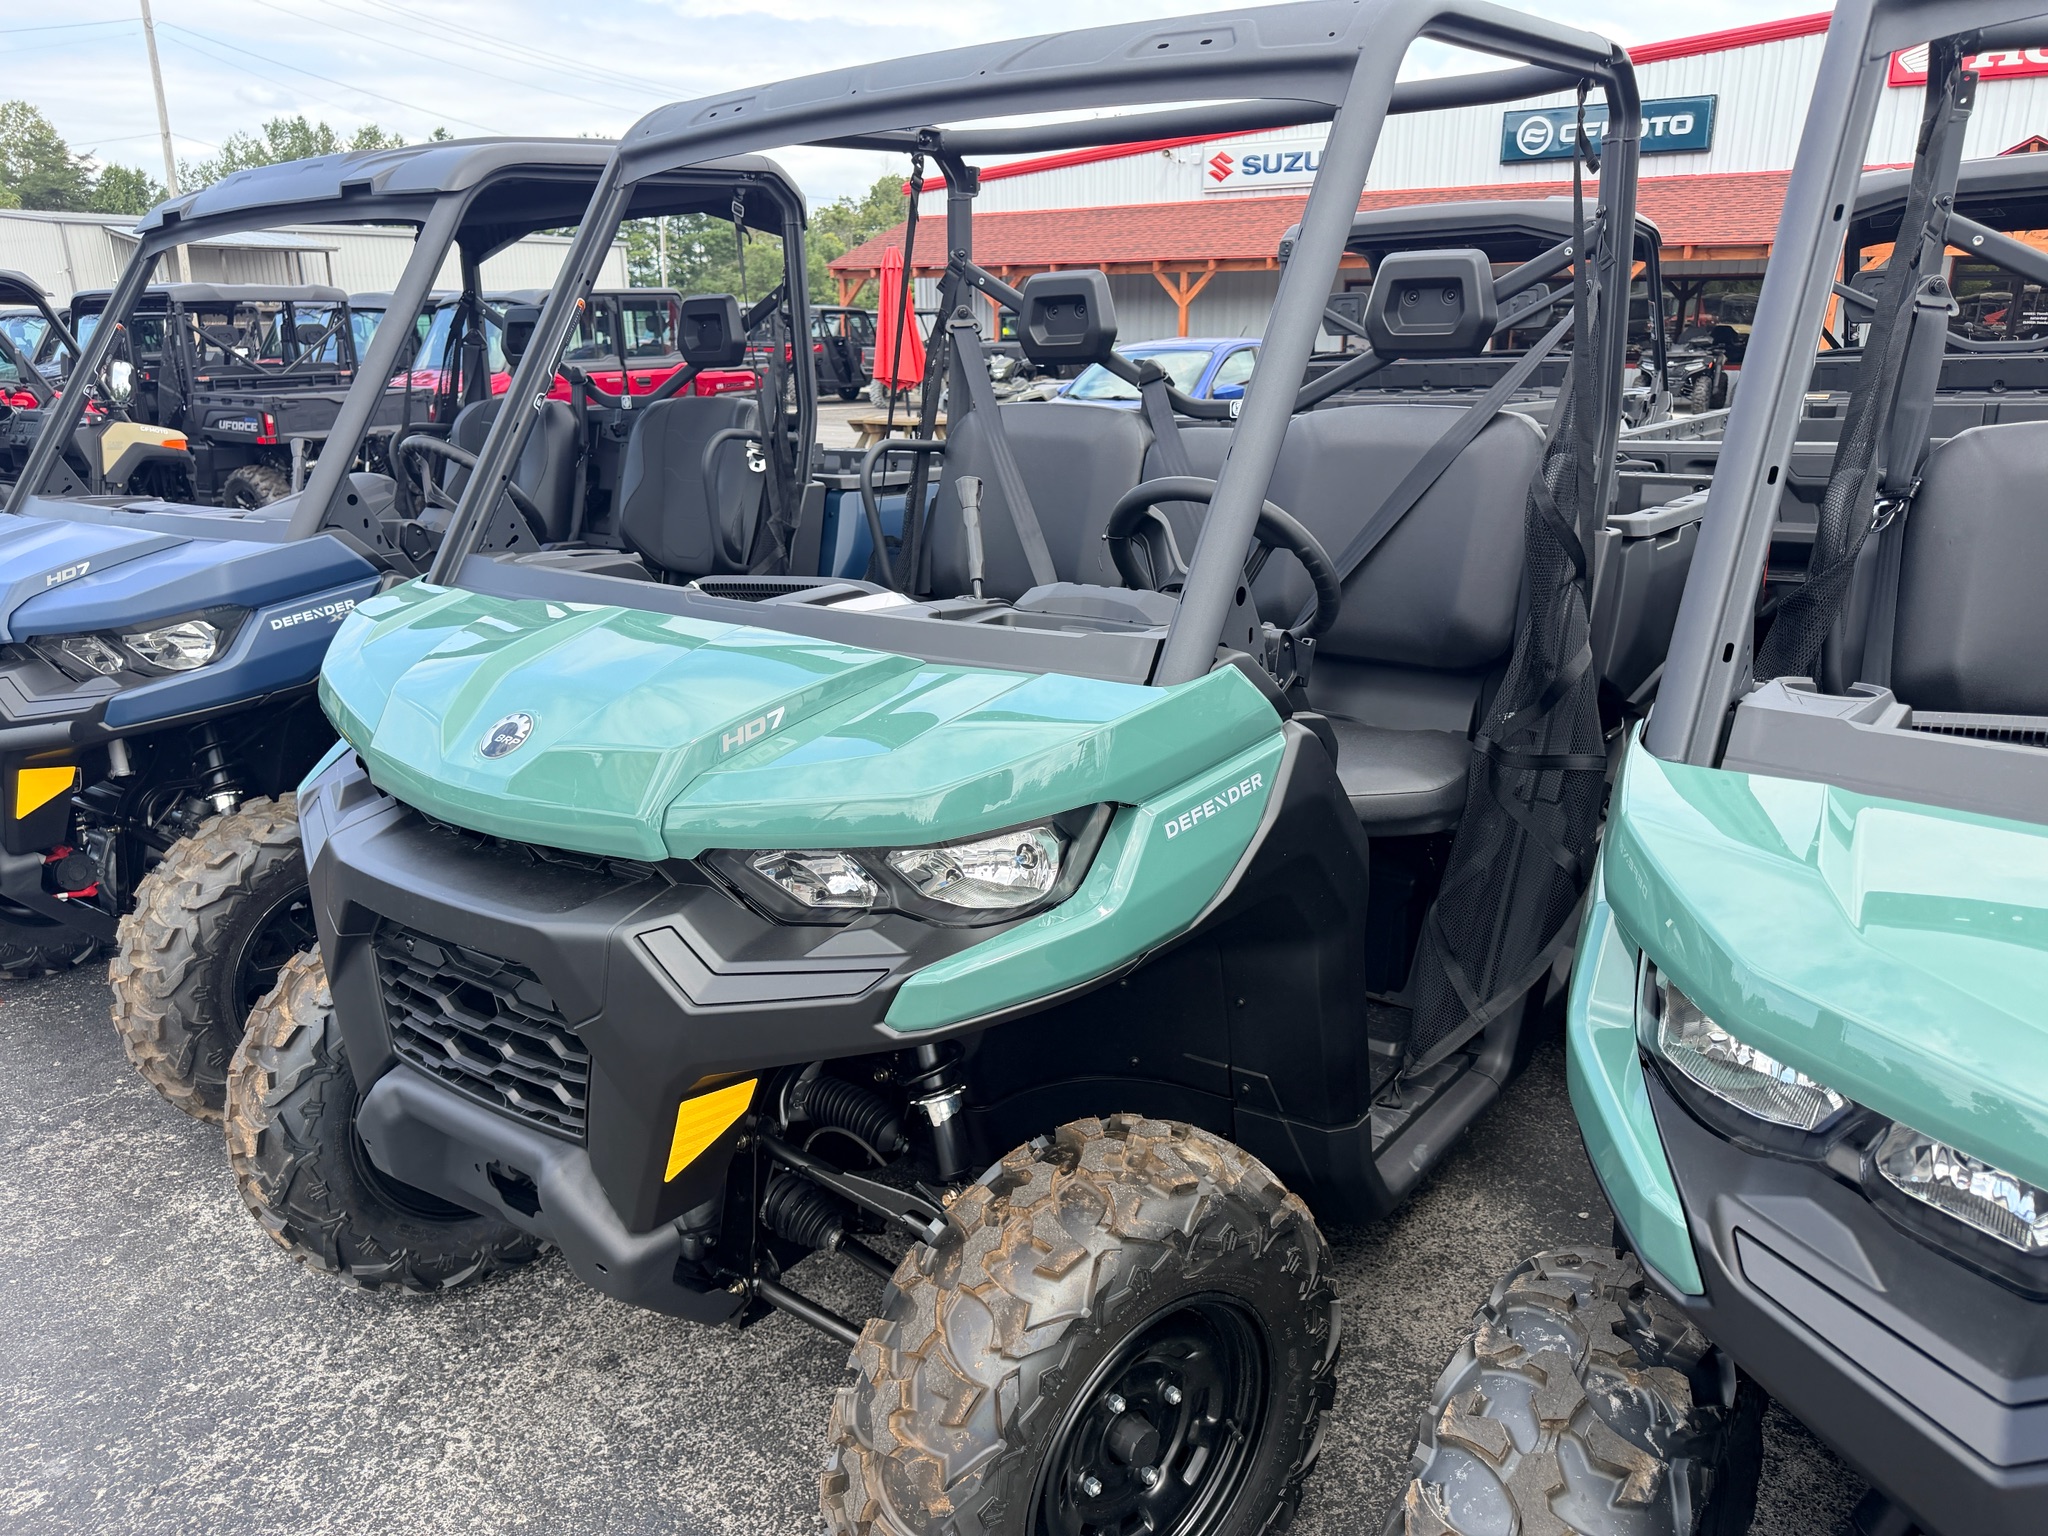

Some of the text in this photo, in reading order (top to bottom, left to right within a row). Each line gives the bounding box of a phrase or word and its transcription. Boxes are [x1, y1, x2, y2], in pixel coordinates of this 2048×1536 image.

[1559, 114, 1694, 144] CFTO
[1241, 150, 1324, 176] SUZU
[218, 419, 258, 432] UFORCE
[46, 561, 90, 586] HD7
[270, 599, 355, 630] DEFENDER
[494, 733, 522, 746] BRP
[722, 706, 785, 753] HD7
[1164, 772, 1263, 839] DEFENDER
